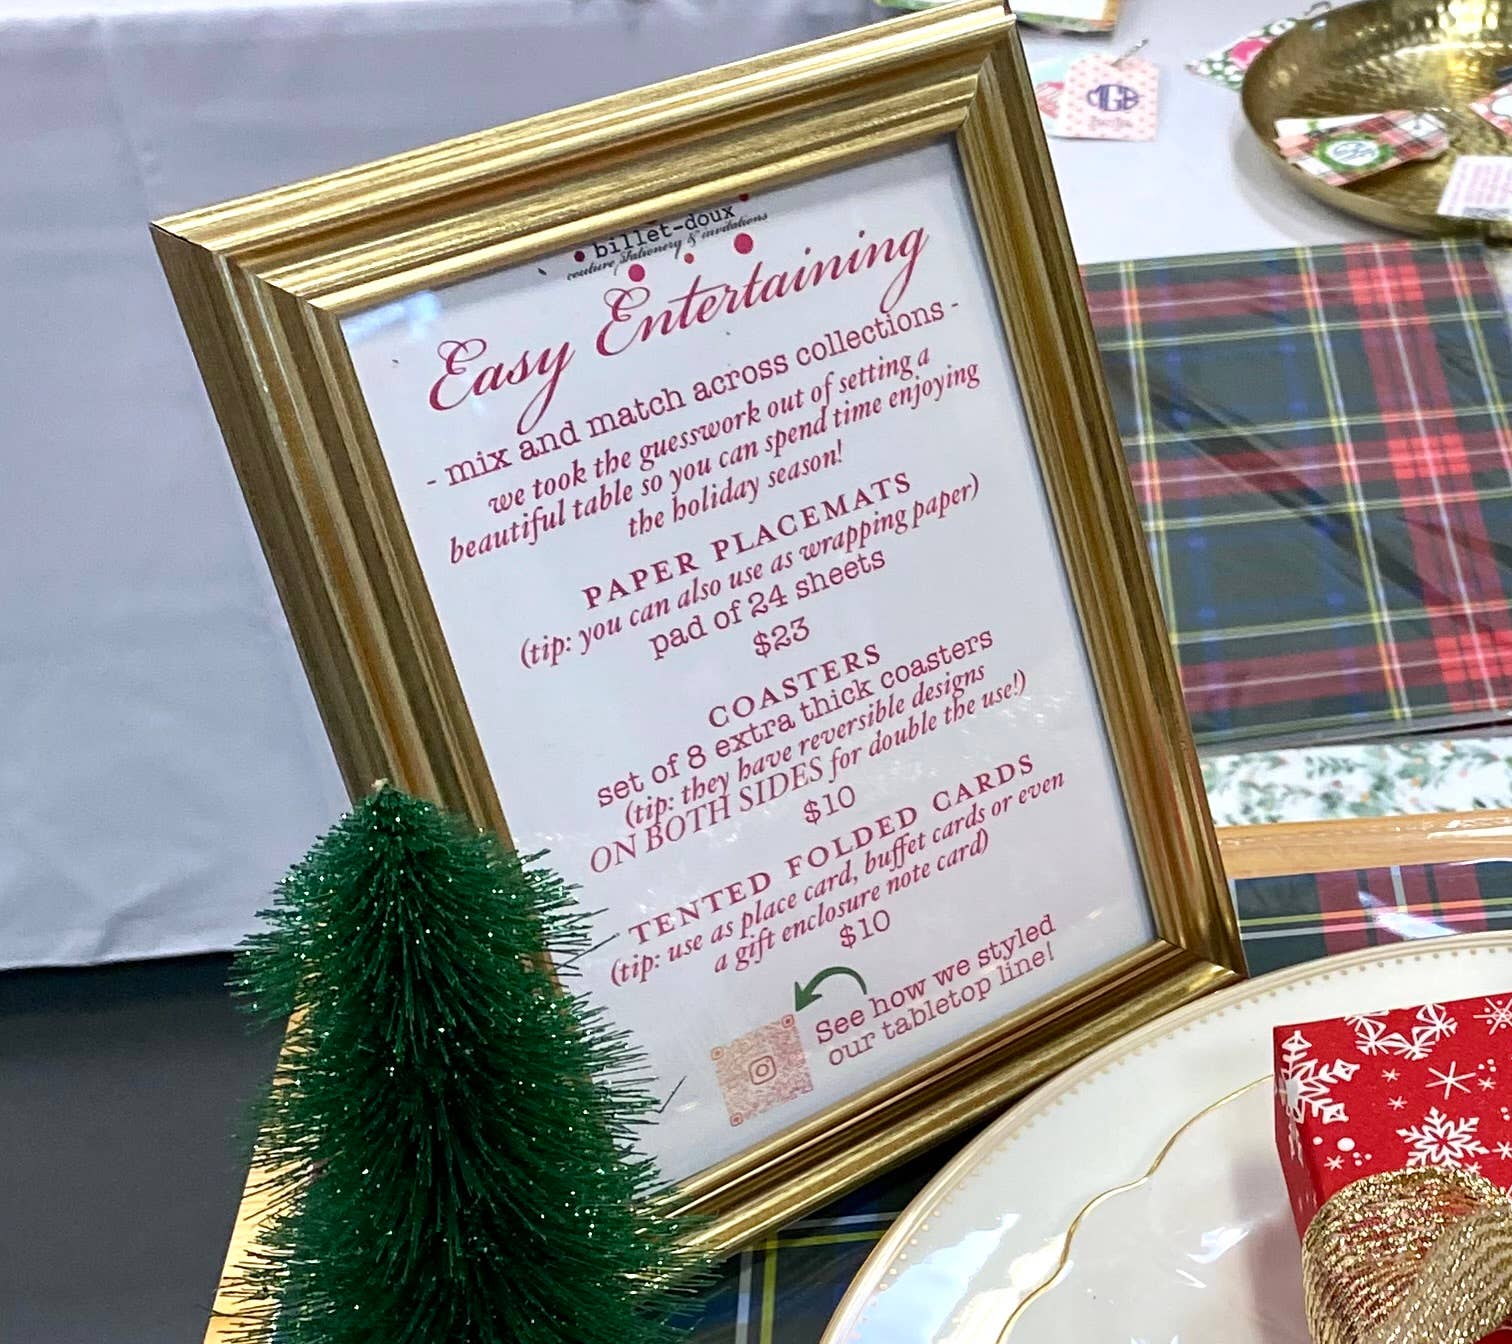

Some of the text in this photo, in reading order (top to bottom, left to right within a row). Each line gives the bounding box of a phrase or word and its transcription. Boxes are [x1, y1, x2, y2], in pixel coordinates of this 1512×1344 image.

[592, 205, 736, 259] billet-doux
[700, 210, 769, 240] invitations
[428, 225, 931, 437] Easy Entertaining
[443, 446, 514, 488] mix
[517, 418, 584, 463] and
[584, 386, 689, 440] match
[691, 352, 790, 403] across
[794, 300, 946, 368] collections
[449, 362, 982, 566] beautiful table so you can spend time enjoying
[486, 346, 931, 515] we took the guesswork out of setting a
[627, 437, 844, 539] the holiday season!
[519, 471, 981, 670] (tip: you can also use as wrapping paper)
[580, 470, 912, 612] PAPER PLACEMATS
[647, 548, 887, 663] pad of 24 sheets
[707, 642, 882, 729] COASTERS
[751, 614, 811, 660] $23
[589, 667, 1028, 875] ON BOTH SIDES for double the use!)
[596, 629, 995, 810] set of 8 extra thick coasters
[624, 663, 986, 833] (tip: they have reversible designs
[626, 752, 1035, 946] TENTED FOLDED CARDS
[802, 784, 857, 827] $10
[609, 771, 1066, 988] (tip: use as place card, buffet cards or even
[713, 826, 990, 975] a gift enclosure note card)
[838, 908, 892, 951] $10
[814, 912, 1058, 1046] See how we styled
[827, 939, 1056, 1067] our tabletop line!
